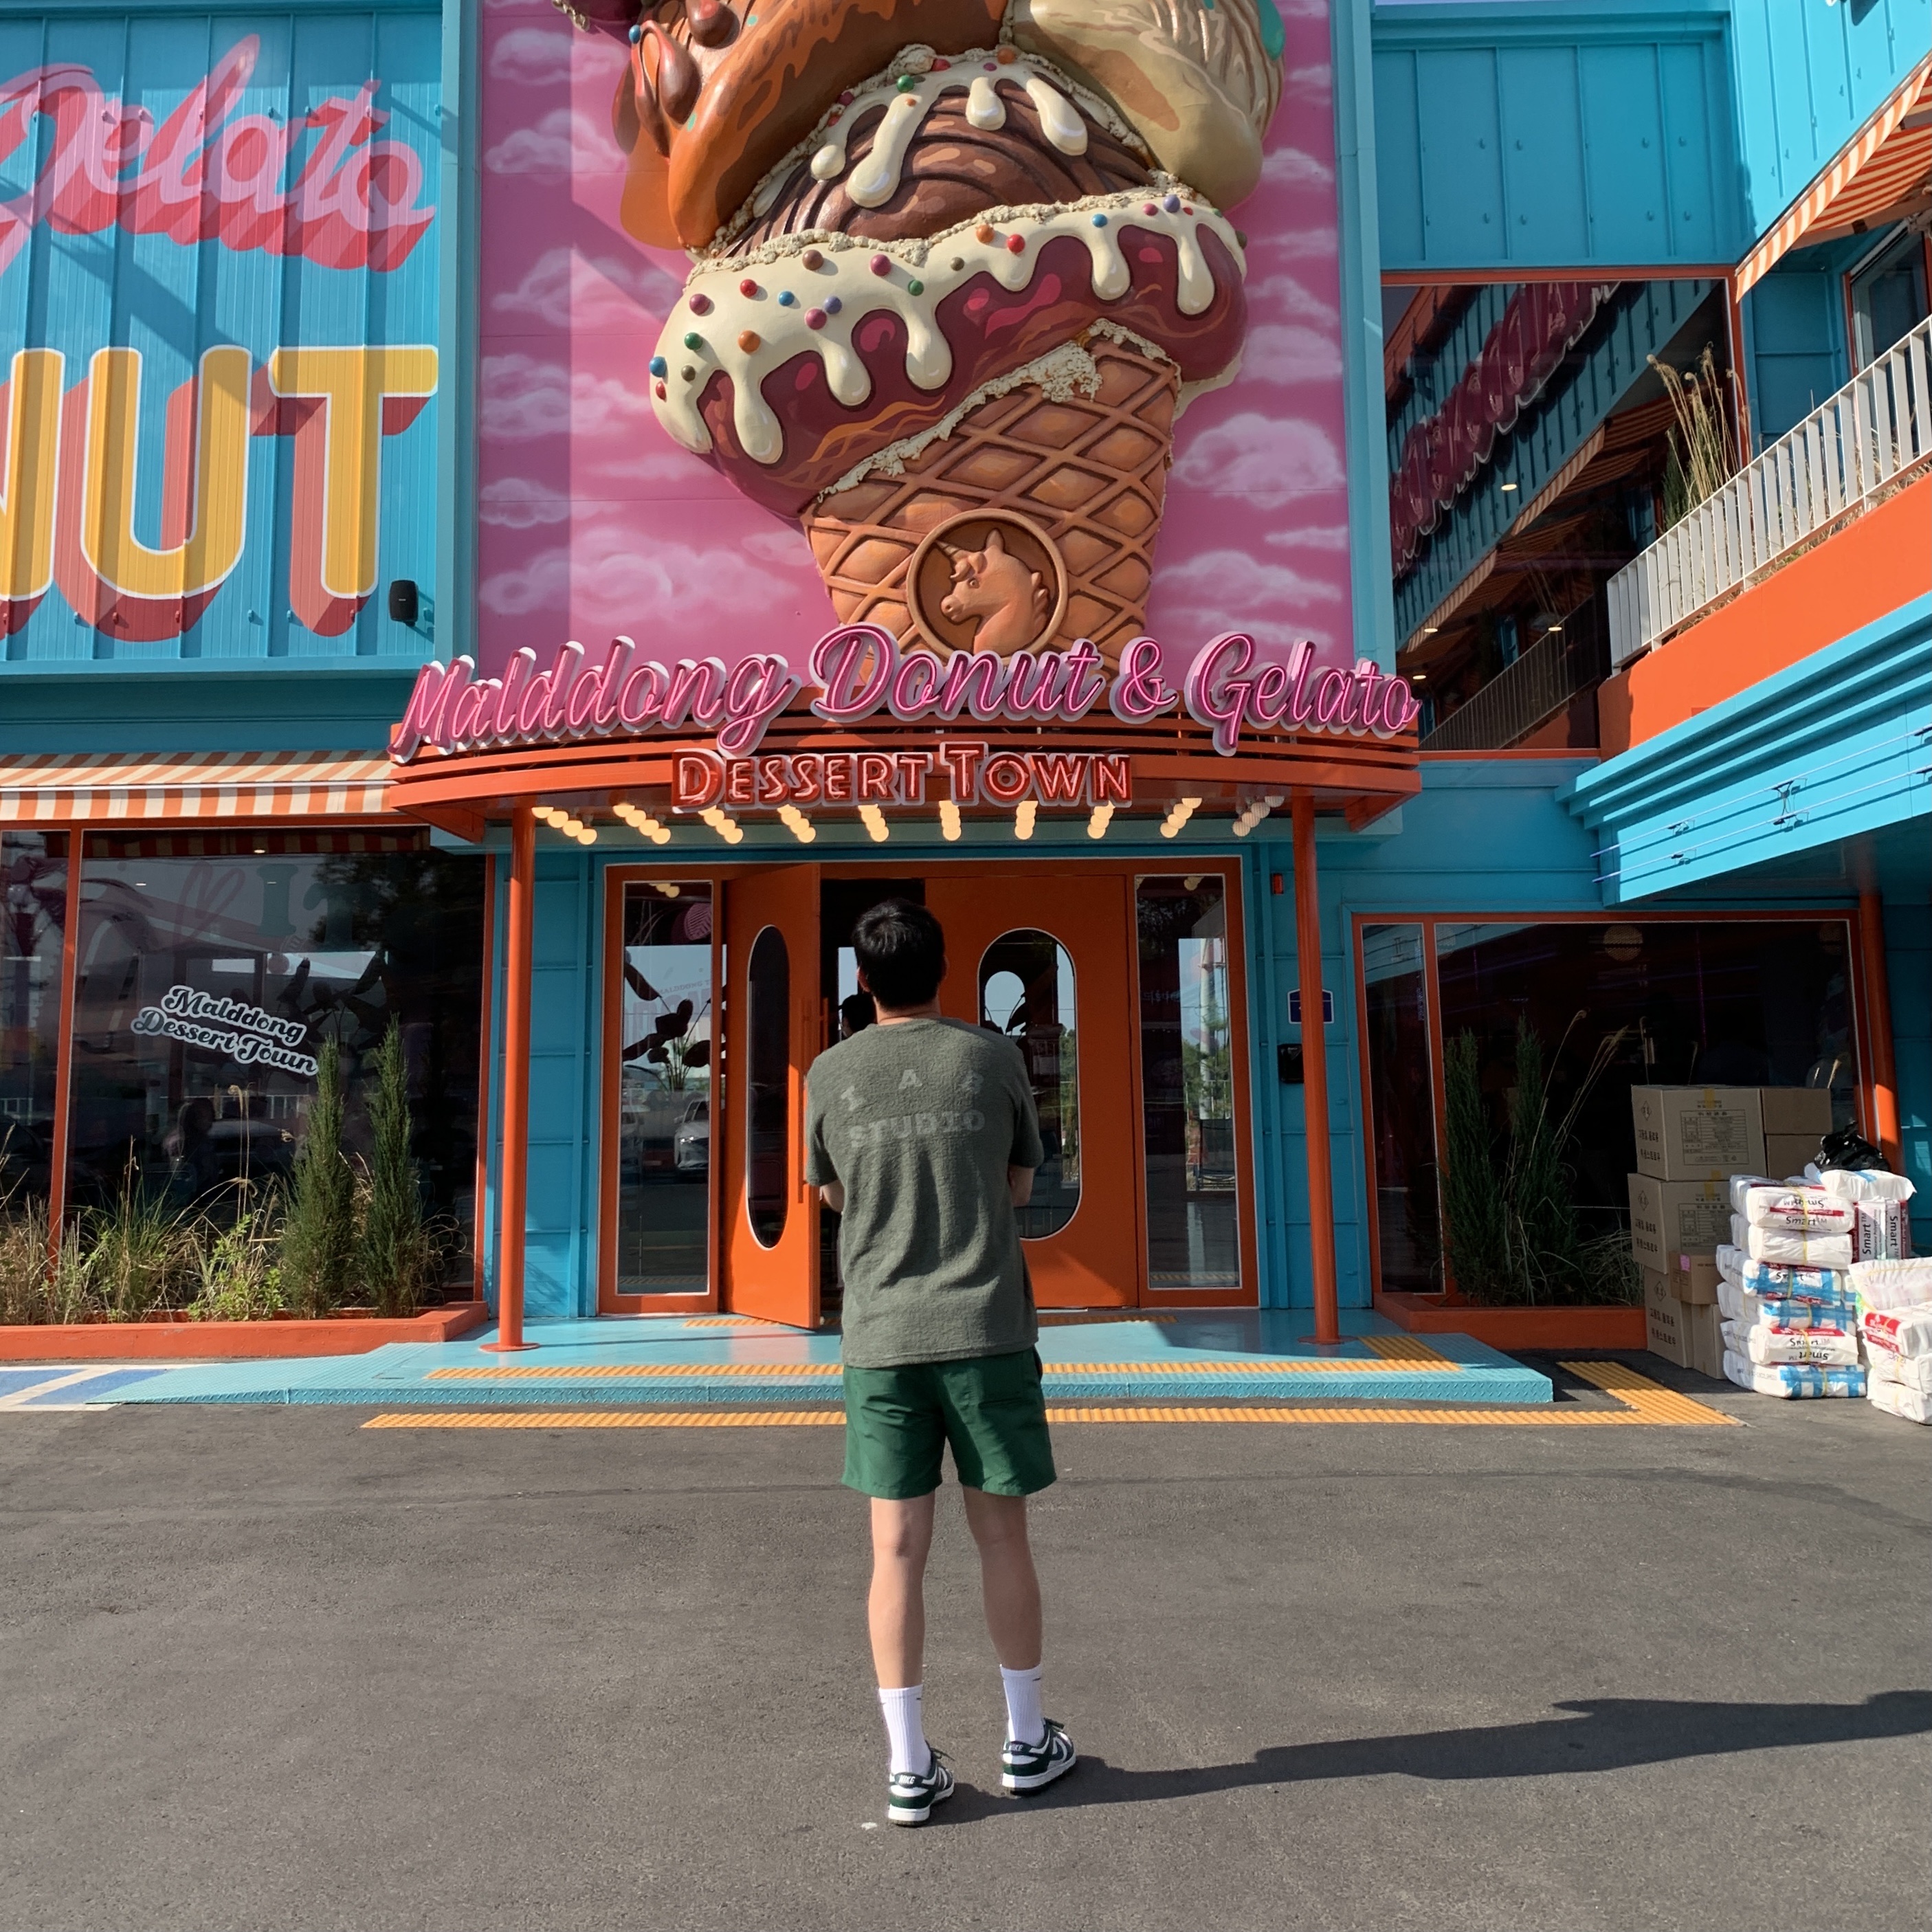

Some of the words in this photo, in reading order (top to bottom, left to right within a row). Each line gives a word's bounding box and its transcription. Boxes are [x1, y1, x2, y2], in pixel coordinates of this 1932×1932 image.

[387, 636, 801, 763] Malddong
[809, 622, 1104, 722] Donut
[1109, 636, 1177, 724] &
[1184, 630, 1422, 756] Gelato
[671, 748, 933, 814] DESSERT
[940, 742, 1132, 807] TOWN
[131, 1006, 239, 1054] Dessert
[234, 1034, 319, 1076] Town
[161, 985, 307, 1047] Malddong
[898, 1775, 916, 1785] NIKE
